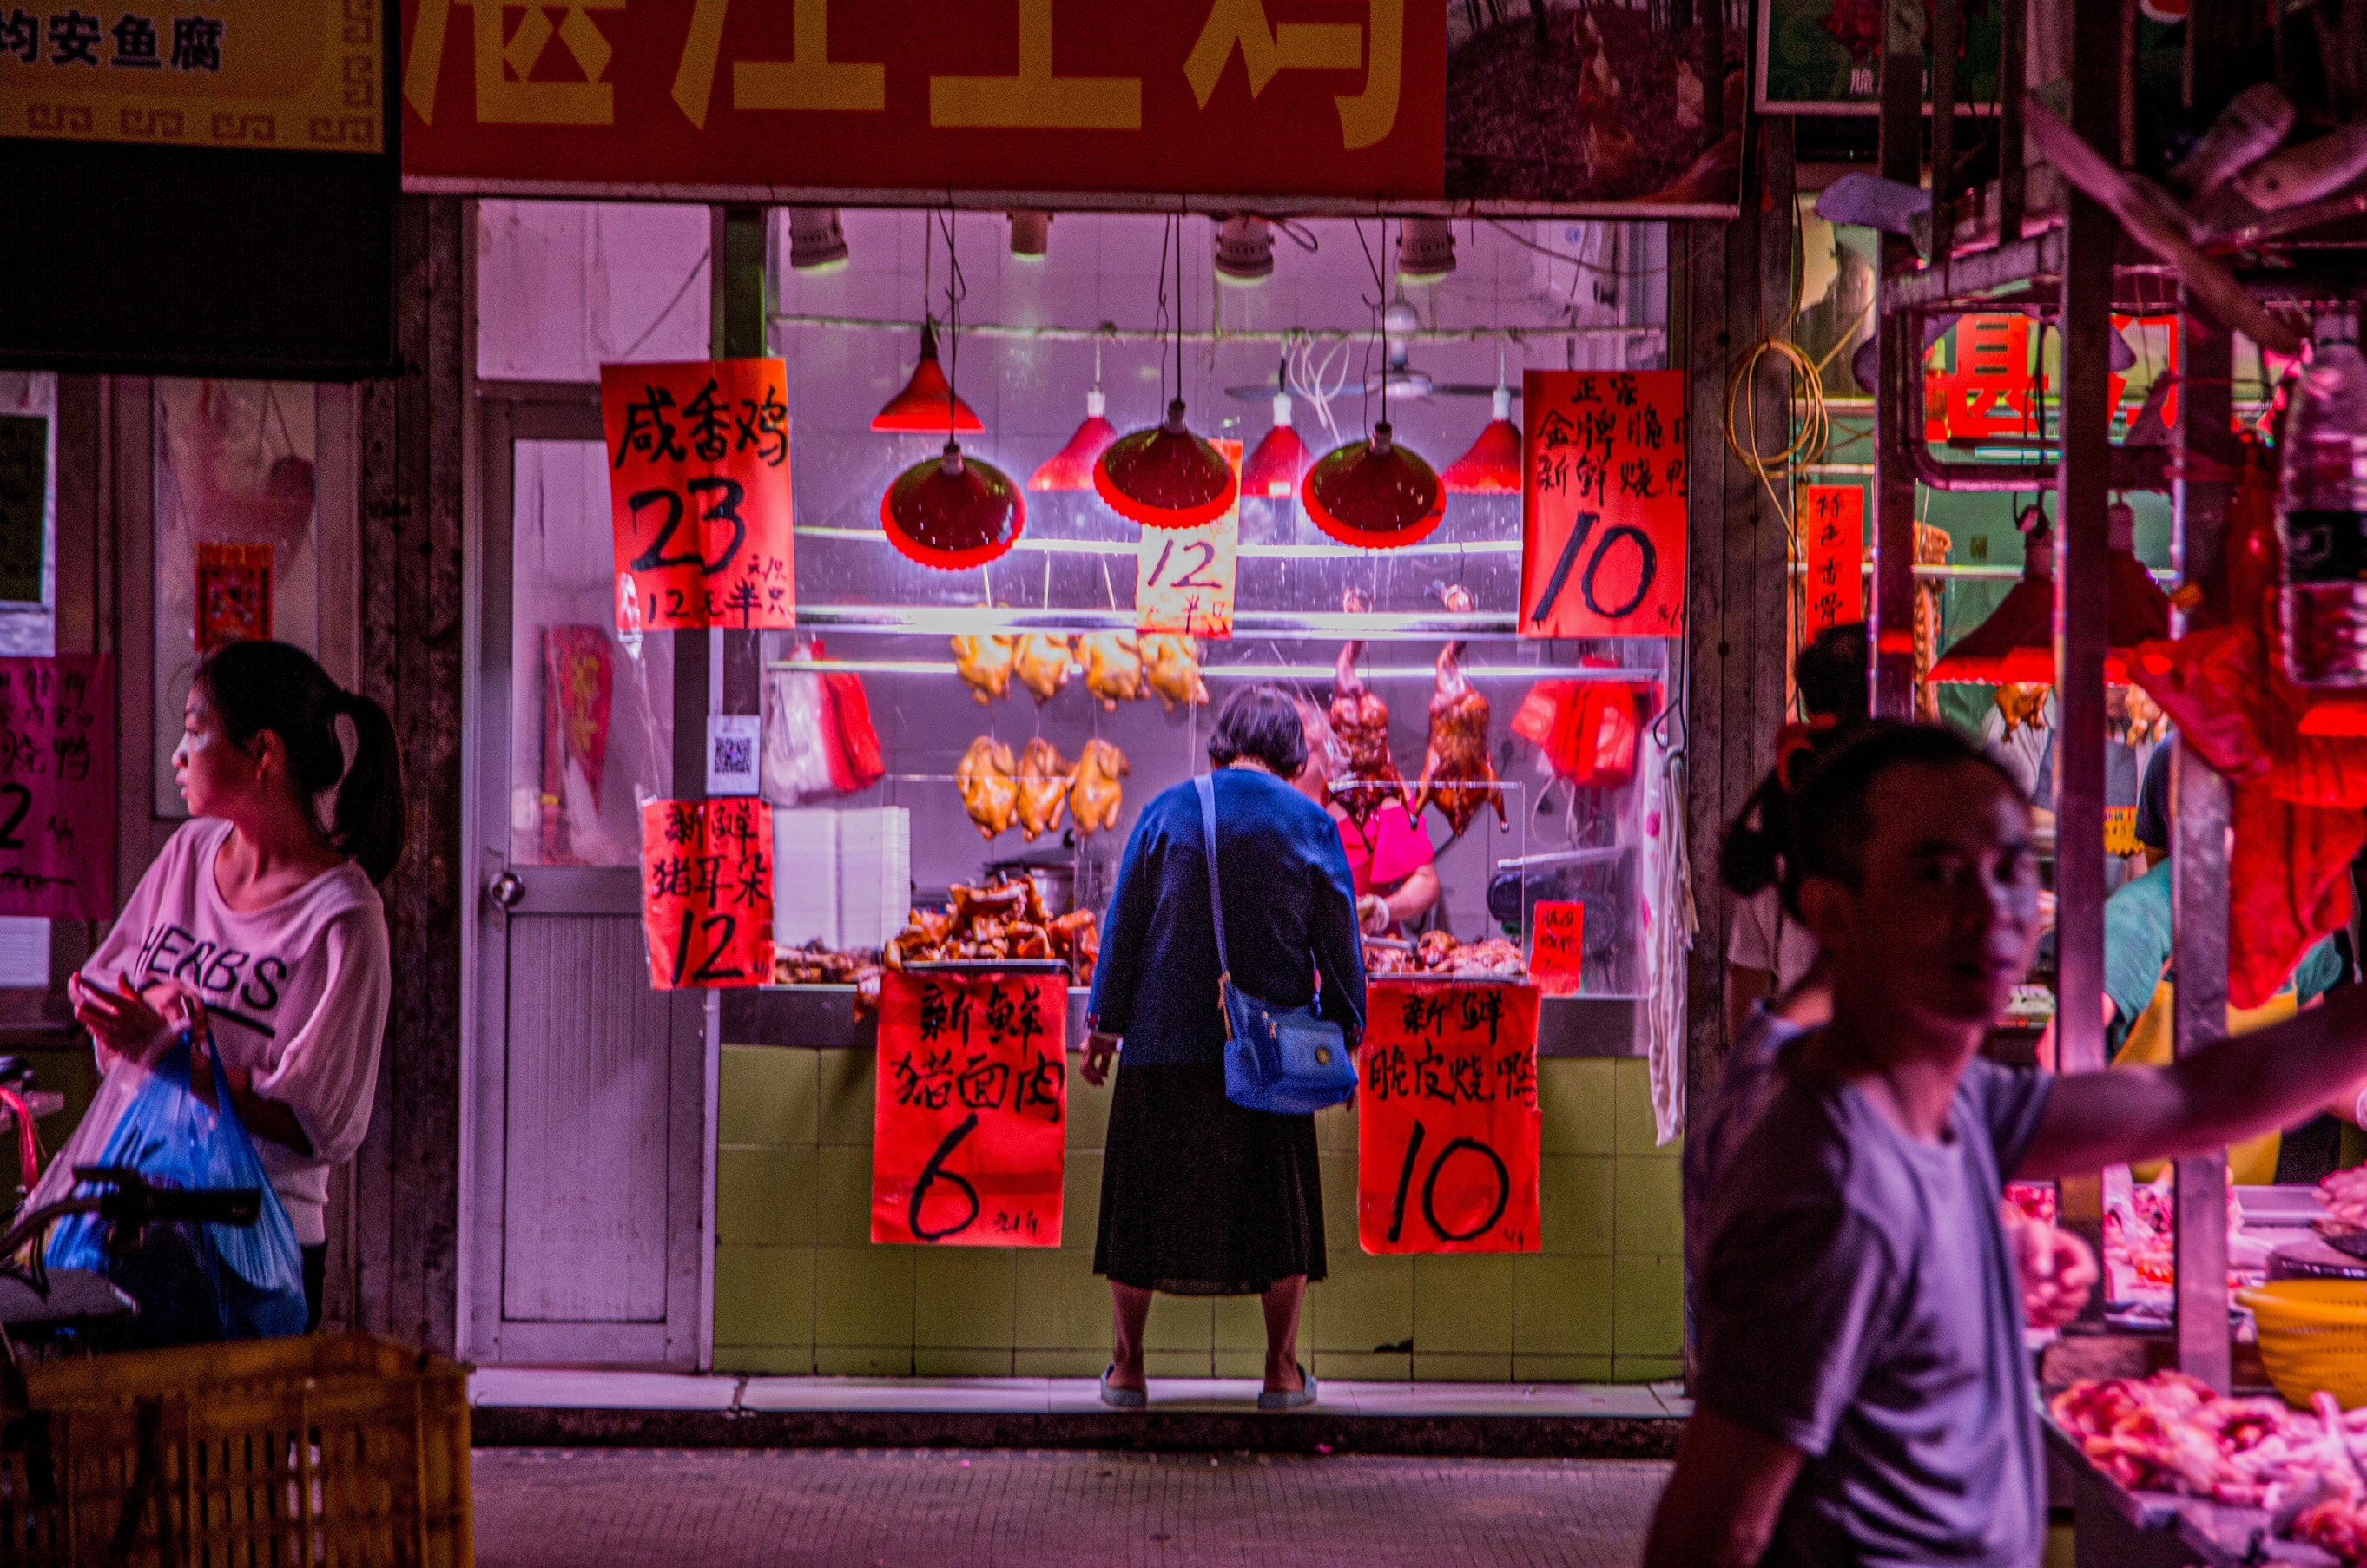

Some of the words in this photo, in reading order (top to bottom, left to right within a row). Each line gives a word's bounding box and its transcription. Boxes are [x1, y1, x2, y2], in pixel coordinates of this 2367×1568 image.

[614, 378, 788, 469] 咸香鸡
[629, 478, 747, 576] 23
[1147, 538, 1222, 588] 12
[1532, 509, 1657, 622] 10
[672, 909, 744, 986] 12
[920, 982, 1043, 1061] 新鲜
[1402, 988, 1505, 1045] 新鲜
[891, 1047, 1065, 1123] 猪面肉
[908, 1111, 980, 1242] 6
[1387, 1118, 1509, 1242] 10
